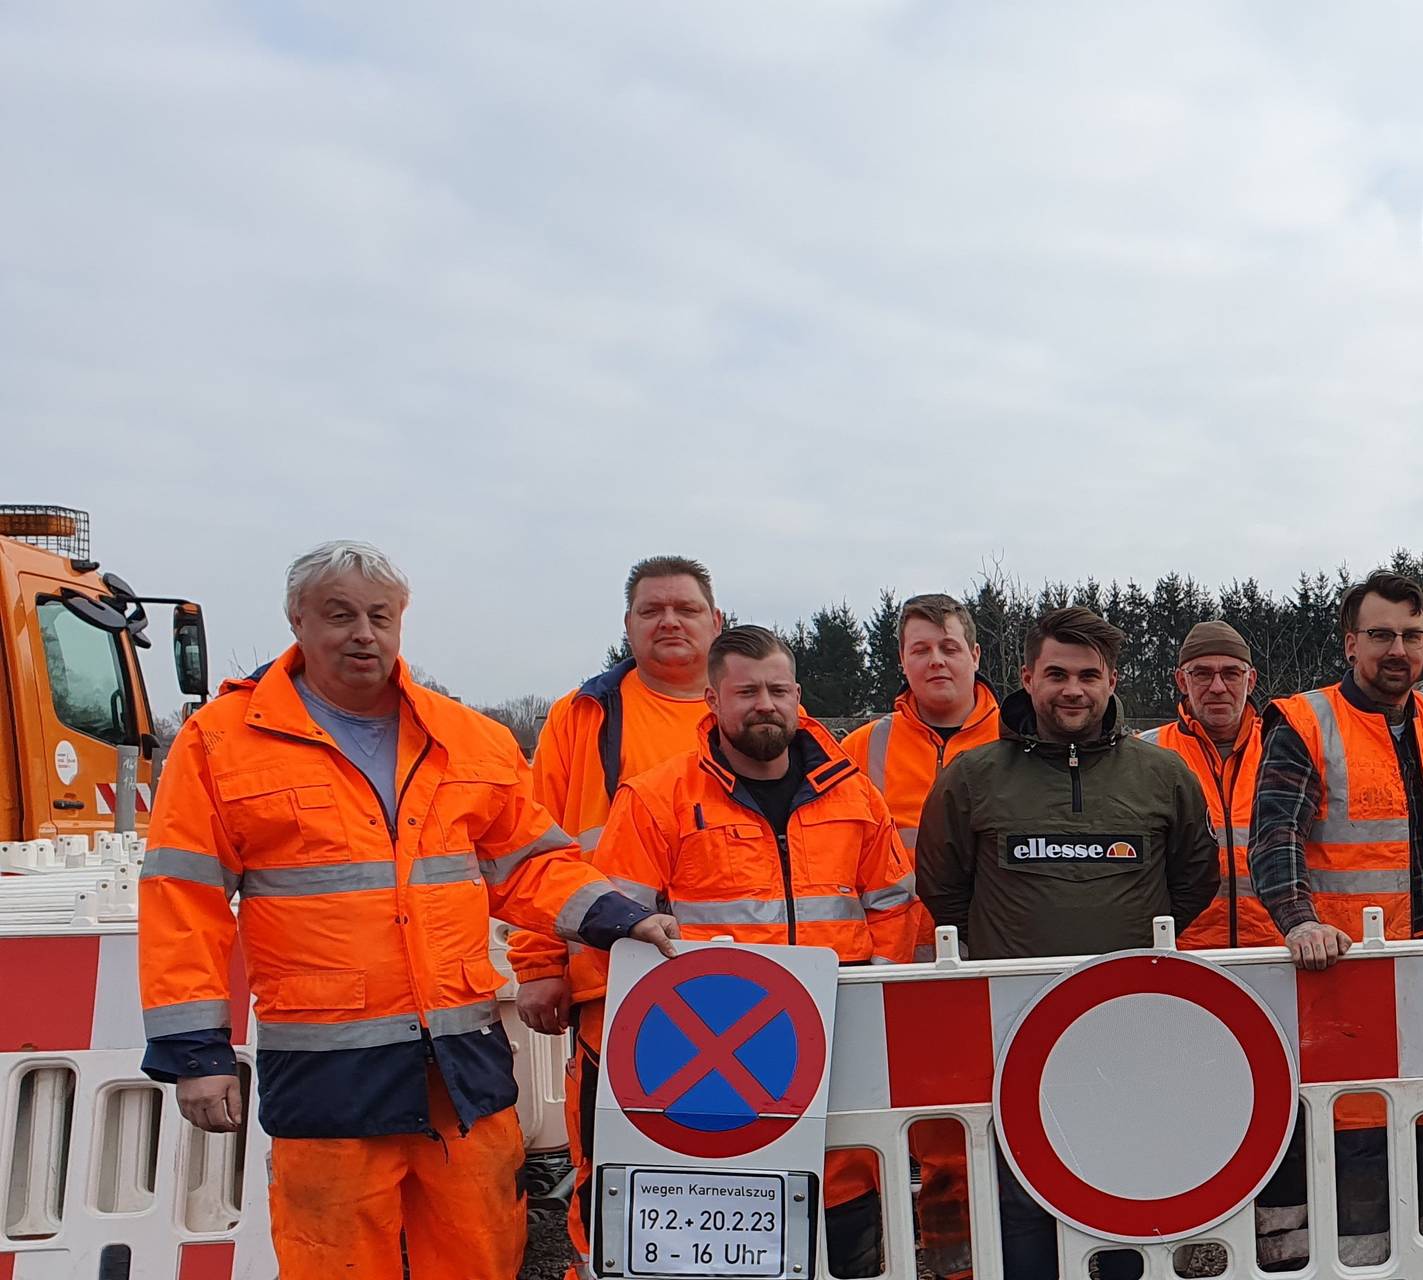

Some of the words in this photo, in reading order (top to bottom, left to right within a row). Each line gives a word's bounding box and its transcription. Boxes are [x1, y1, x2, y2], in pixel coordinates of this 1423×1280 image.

[1013, 837, 1104, 859] ellesse
[641, 1184, 683, 1197] wegen
[688, 1183, 776, 1200] Karnevalszug
[699, 1210, 776, 1232] 20.2.23
[645, 1242, 658, 1263] 8
[691, 1243, 713, 1265] 16
[724, 1243, 767, 1265] Uhr
